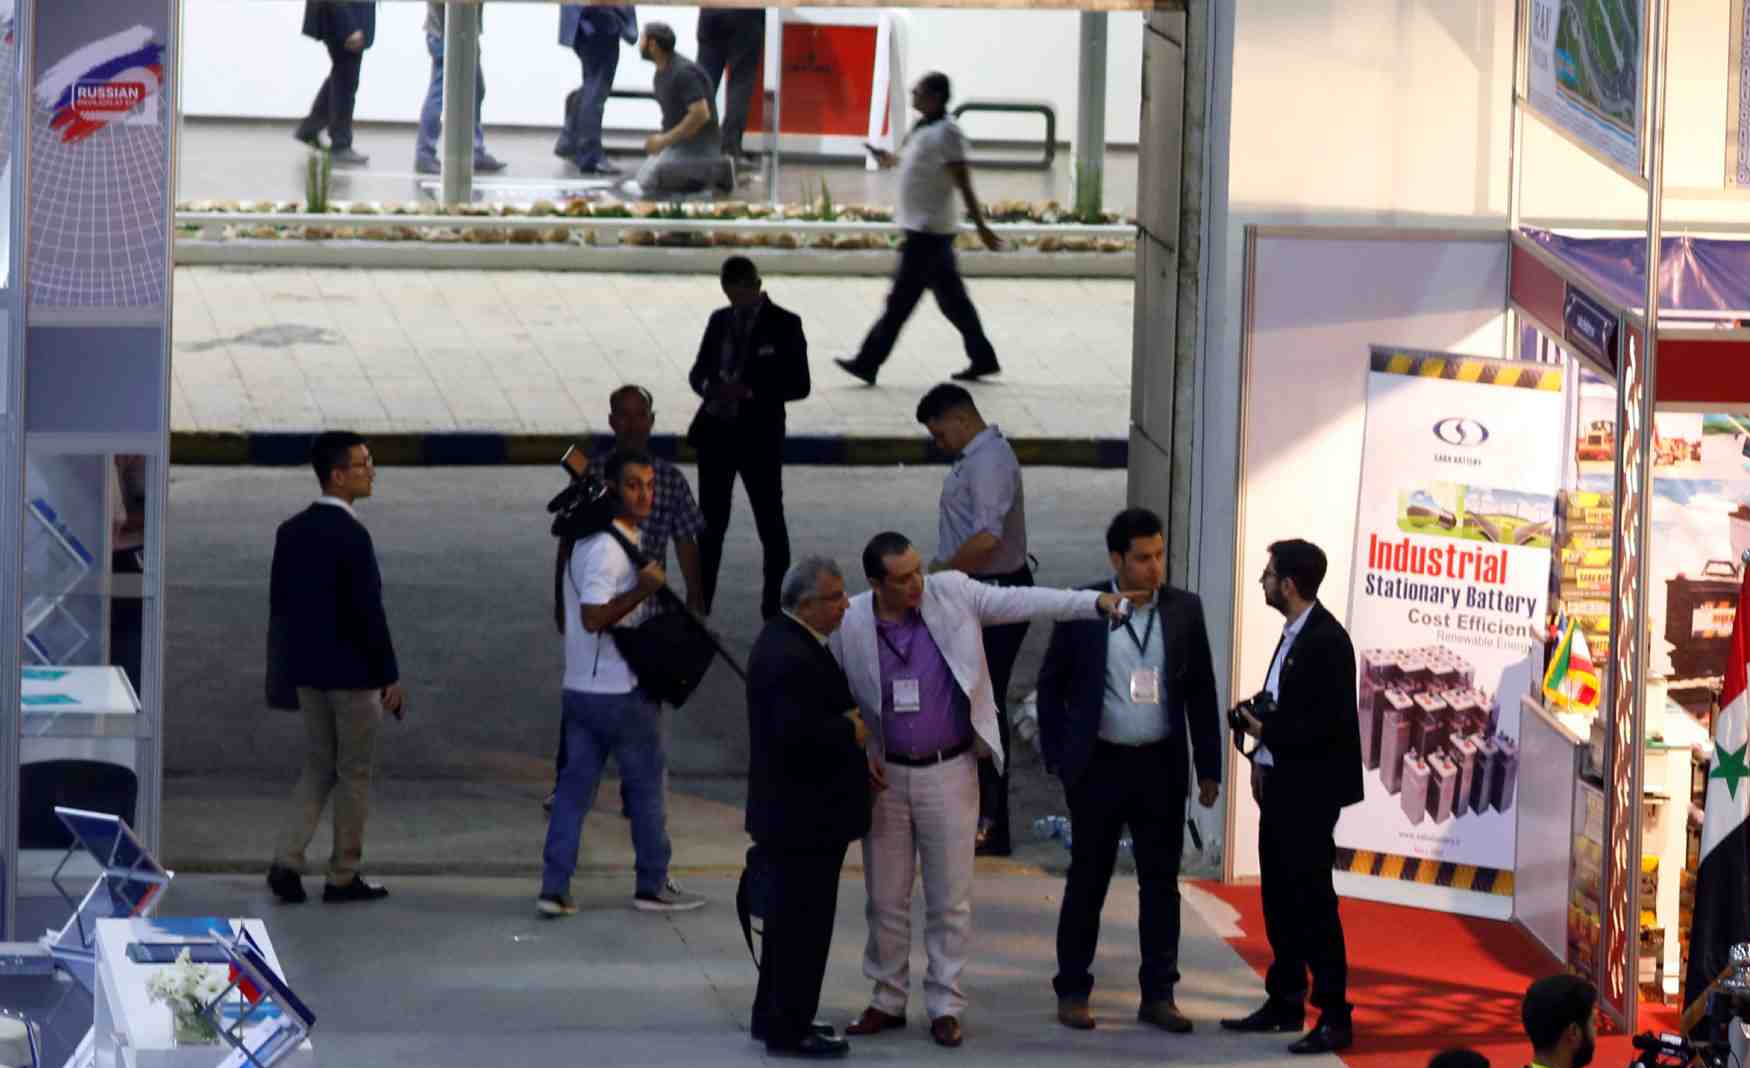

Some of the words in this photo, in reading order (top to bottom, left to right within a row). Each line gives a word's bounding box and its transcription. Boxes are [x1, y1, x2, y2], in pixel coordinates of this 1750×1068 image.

[77, 87, 138, 98] RUSSIAN
[1368, 533, 1508, 585] Industrial
[1365, 573, 1461, 609] Stationary
[1466, 584, 1537, 618] Battery
[1408, 609, 1450, 626] Cost
[1457, 614, 1537, 638] Efficient
[1436, 630, 1494, 647] Renewable
